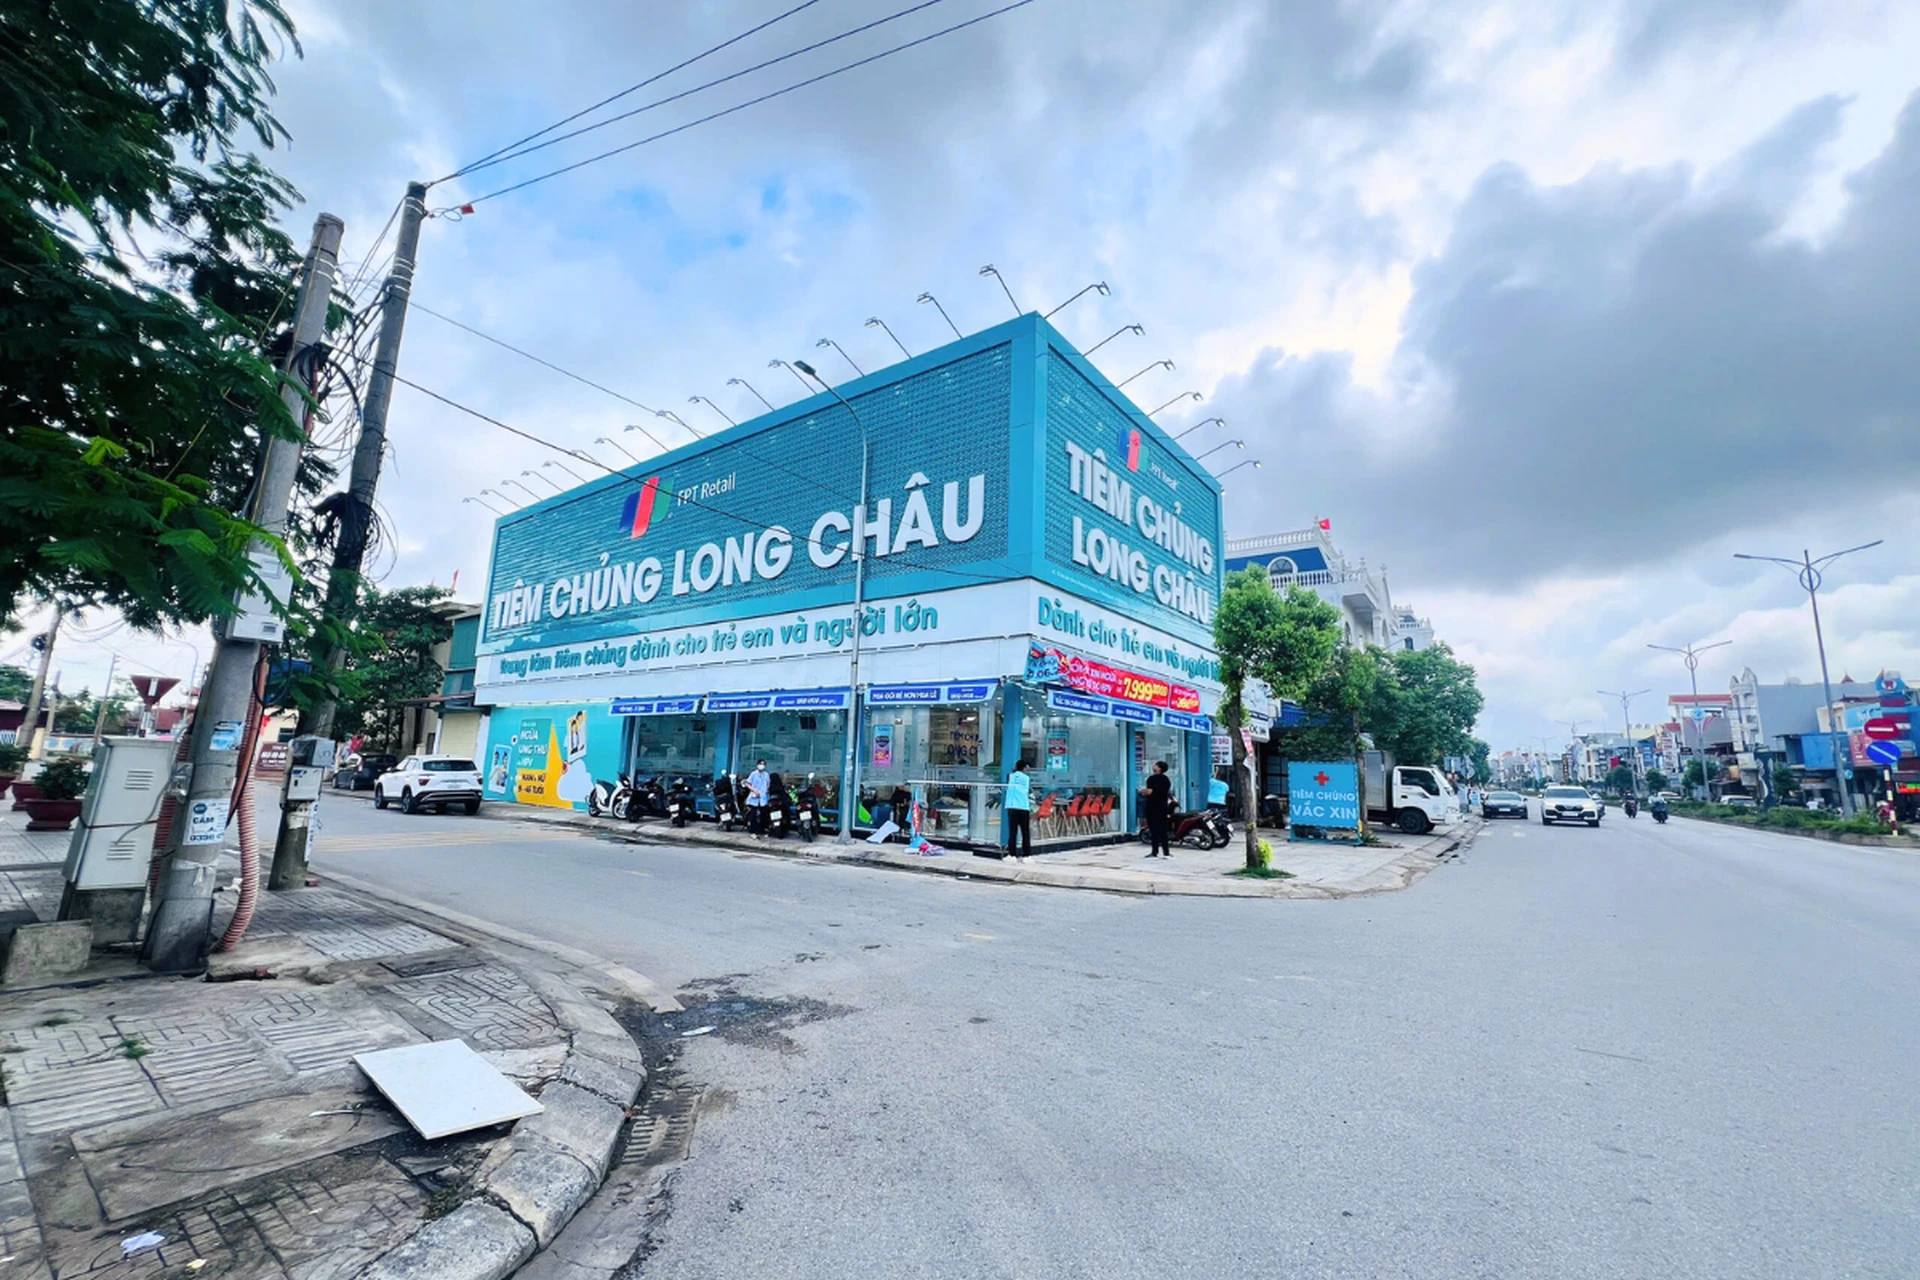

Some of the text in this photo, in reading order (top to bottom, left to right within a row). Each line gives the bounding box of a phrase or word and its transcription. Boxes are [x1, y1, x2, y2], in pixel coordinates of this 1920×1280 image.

[677, 471, 737, 506] FPT Retail
[1066, 440, 1214, 575] TIÊM CHỦNG
[492, 471, 986, 630] TIÊM CHỦNG LONG CHÂU
[1071, 516, 1150, 594] LONG
[1153, 564, 1211, 624] CHÂU
[584, 641, 628, 668] chủng
[629, 636, 671, 662] dành
[673, 631, 708, 657] cho
[711, 622, 738, 652] trẻ
[741, 626, 774, 649] em
[780, 614, 809, 643] và
[894, 598, 939, 633] lớn
[1038, 596, 1086, 638] Dành
[1088, 619, 1118, 648] cho
[1292, 788, 1356, 802] TIÊM CHỦNG
[1329, 805, 1358, 820] XIN
